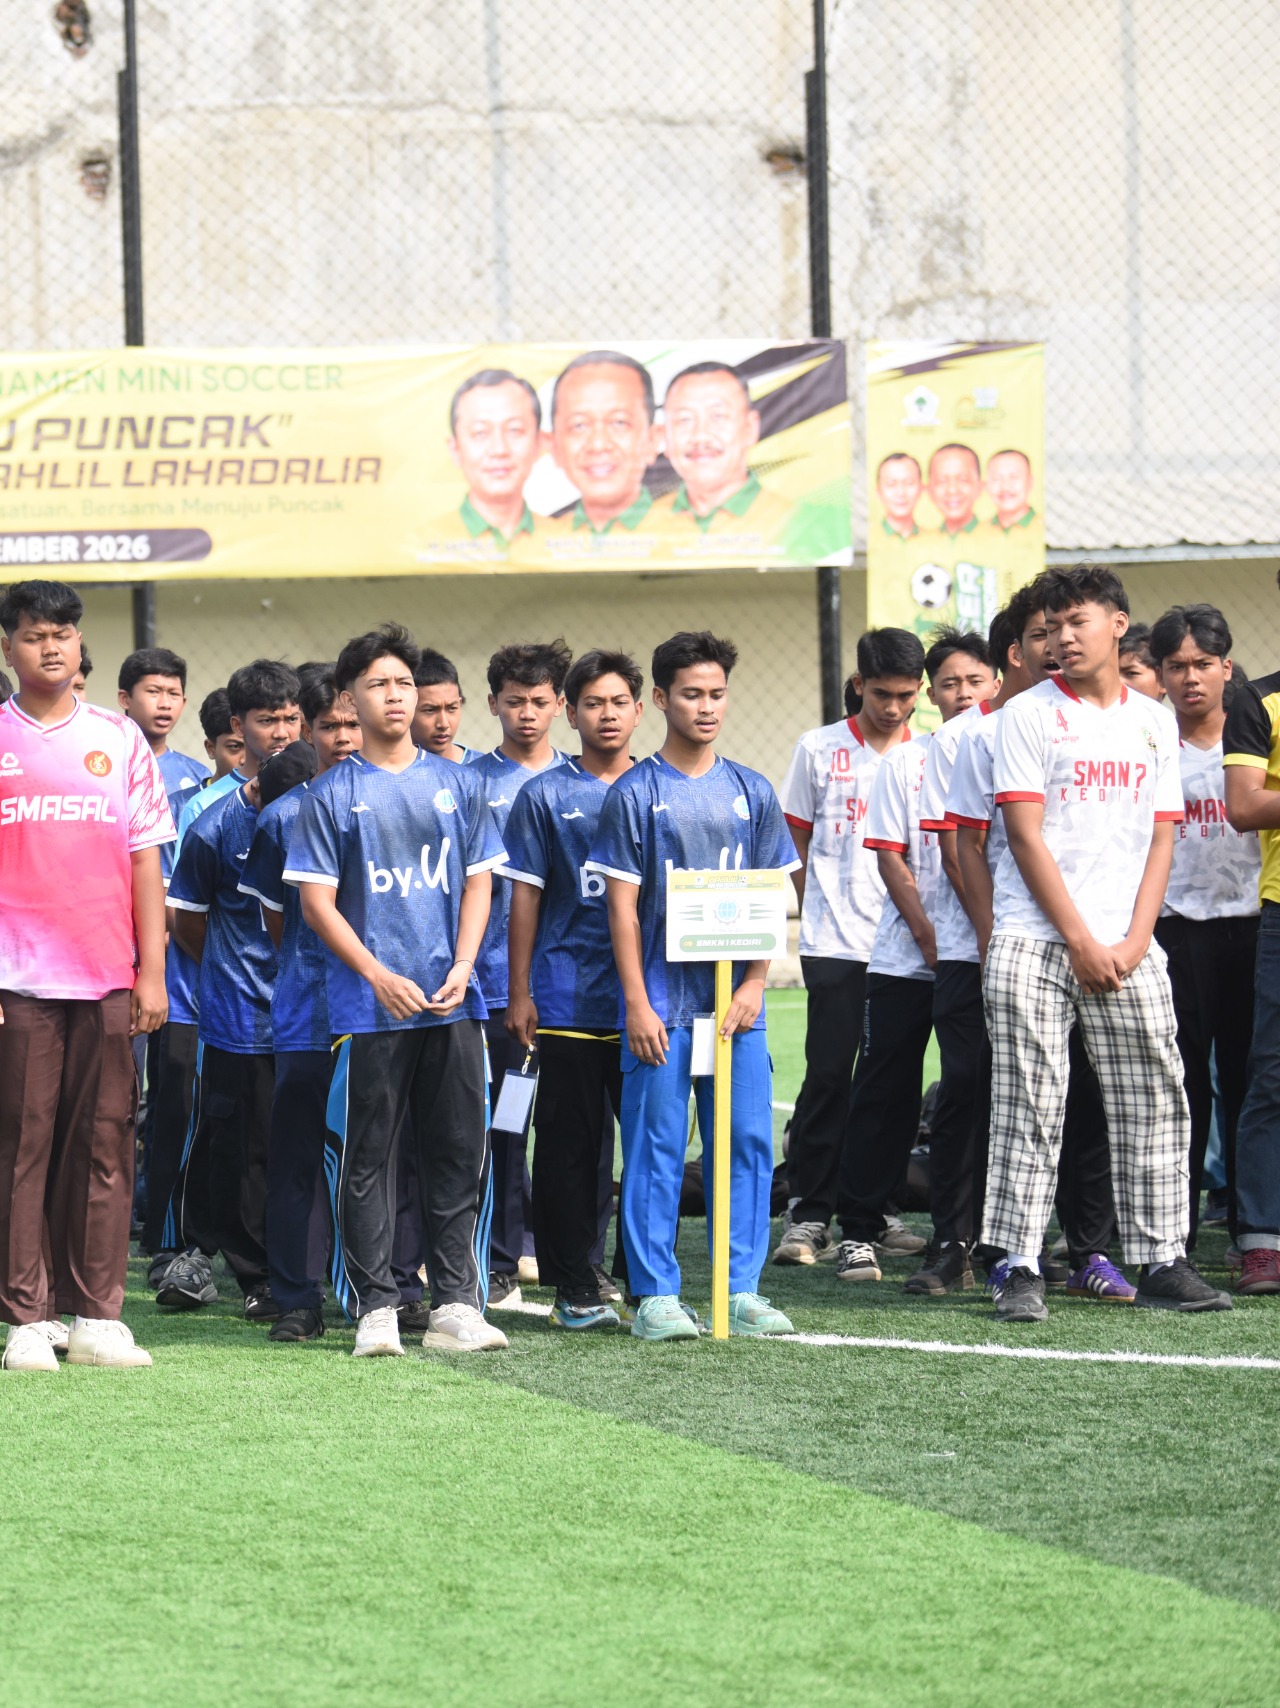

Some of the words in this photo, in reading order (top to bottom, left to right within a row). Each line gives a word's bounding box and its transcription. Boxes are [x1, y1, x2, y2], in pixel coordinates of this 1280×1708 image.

[118, 366, 191, 393] MINI
[203, 364, 344, 391] SOCCER
[32, 413, 293, 451] PUNCAK"
[122, 457, 382, 487] LAHADALIA
[83, 498, 175, 517] Bersama
[182, 497, 261, 519] Menuju
[268, 494, 346, 513] Puncak
[83, 535, 151, 562] 2026
[1056, 708, 1069, 732] 4
[831, 747, 850, 773] 10
[1073, 760, 1130, 788] SMAN
[0, 795, 118, 826] SMASAL
[846, 798, 868, 821] SM
[1183, 798, 1229, 825] MAN
[696, 939, 725, 947] SMKN
[730, 938, 762, 946] KEDIRI
